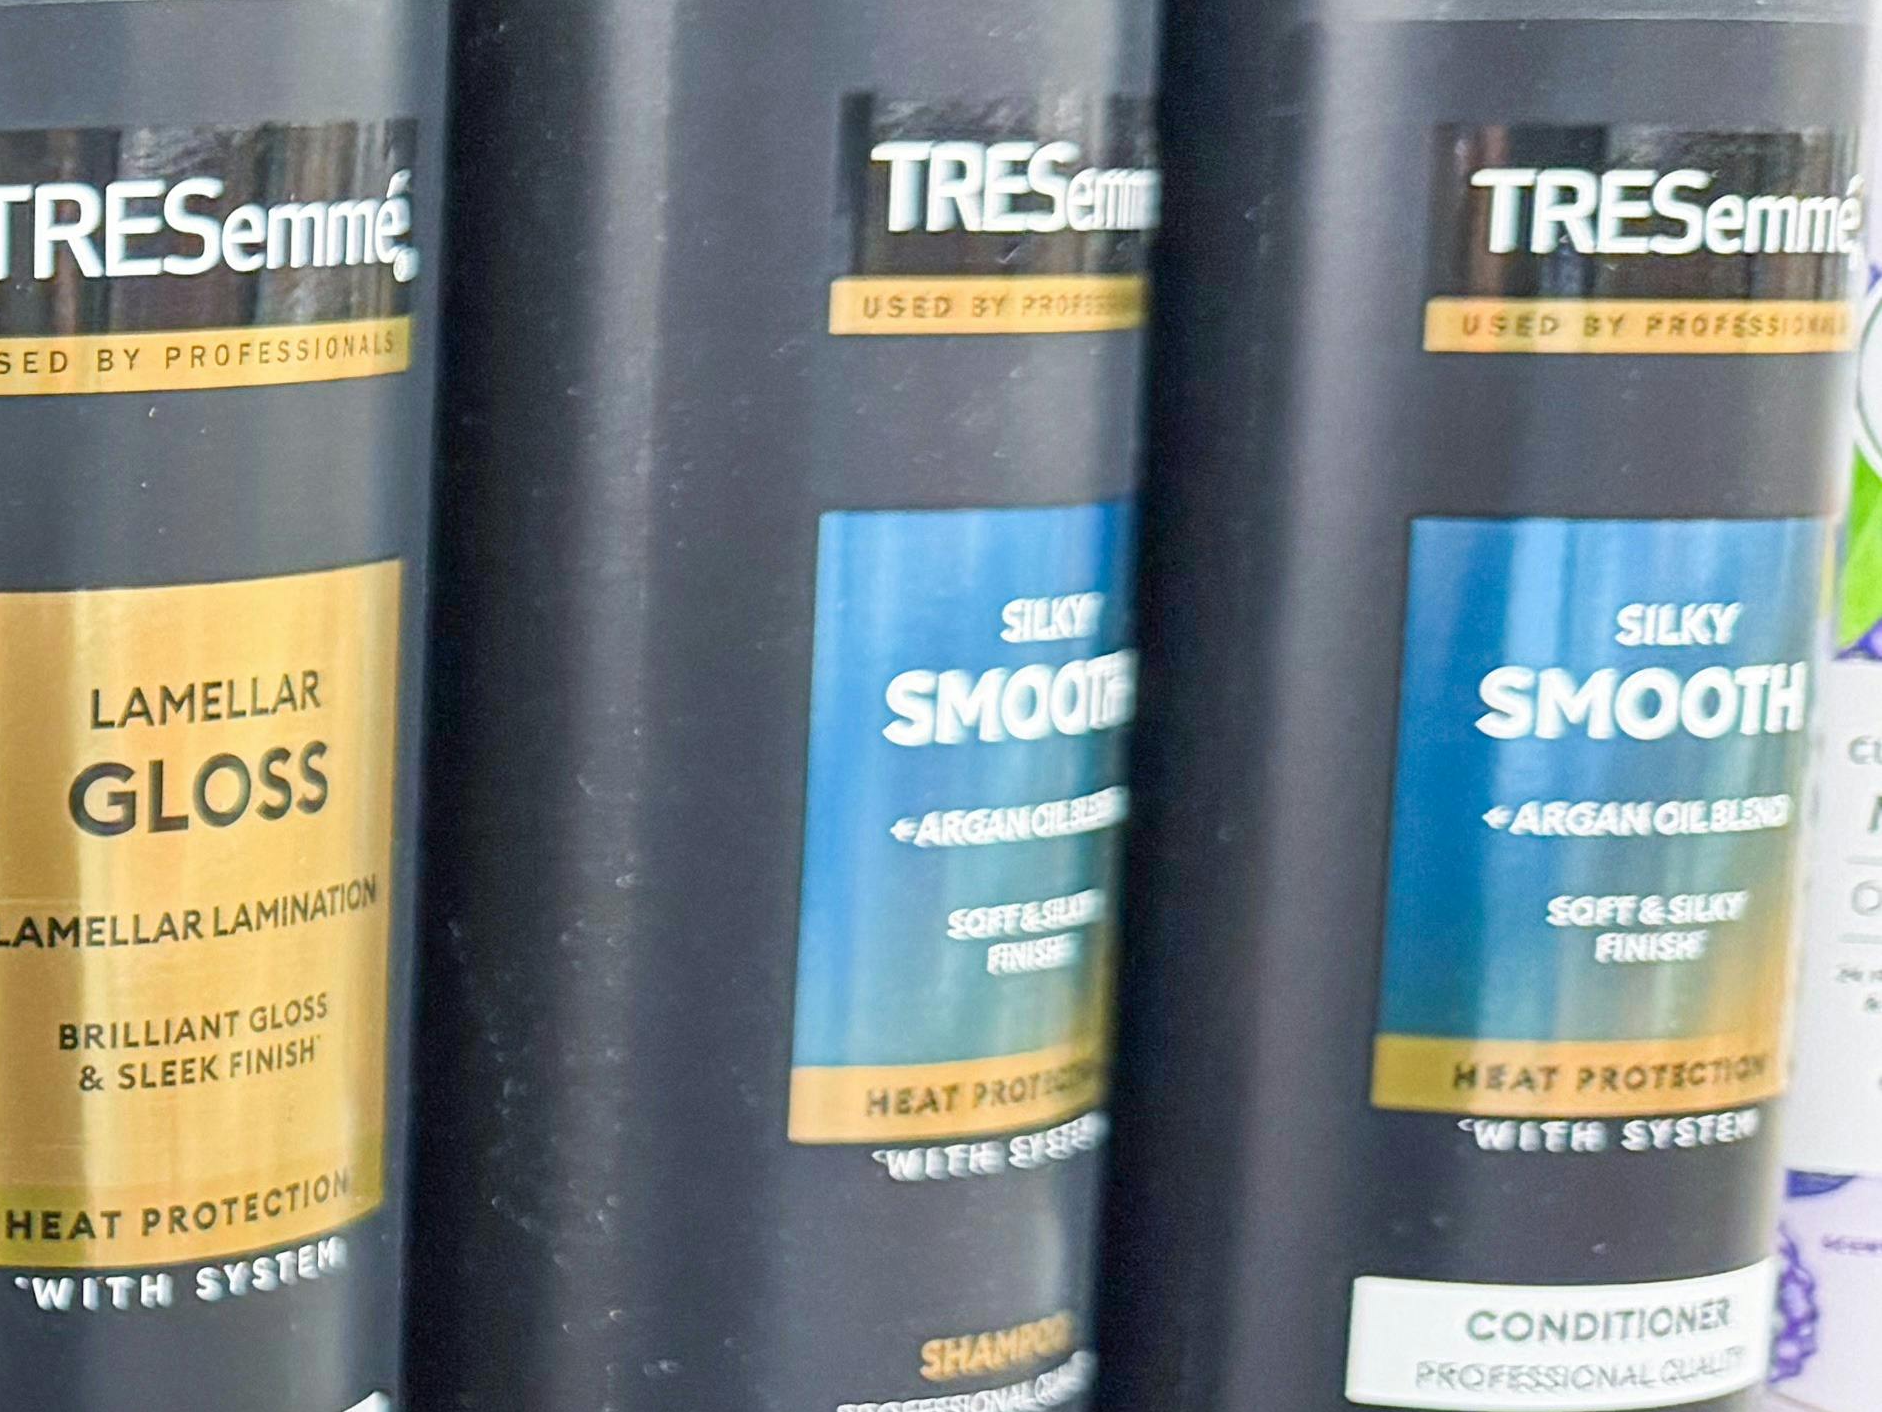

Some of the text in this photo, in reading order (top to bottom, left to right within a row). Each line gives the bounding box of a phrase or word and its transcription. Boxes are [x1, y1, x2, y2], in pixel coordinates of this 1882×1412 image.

[863, 295, 952, 319] USED
[971, 294, 1007, 318] BY
[1462, 314, 1559, 337] USED
[1584, 312, 1626, 337] BY
[98, 348, 139, 372] BY
[166, 331, 395, 368] PROFESSIONALS
[1000, 591, 1105, 643] SILKY
[1615, 602, 1744, 647] SILKY
[90, 669, 321, 731] LAMELLAR
[1474, 661, 1808, 740] SMOOTH
[68, 740, 328, 837] GLOSS
[1654, 799, 1710, 834] OIL
[213, 874, 377, 936] LAMINATION
[59, 993, 328, 1051] BRILLIANT GLOSS
[79, 1057, 219, 1091] & SLEEK
[1453, 1063, 1559, 1091] HEAT
[865, 1085, 960, 1118] HEAT
[1622, 1108, 1760, 1151] SYSTEM
[6, 1210, 123, 1240] HEAT
[196, 1236, 348, 1300] SYSTEM
[1466, 1297, 1730, 1342] CONDITIONER
[1416, 1360, 1654, 1389] PROFESSIONAL
